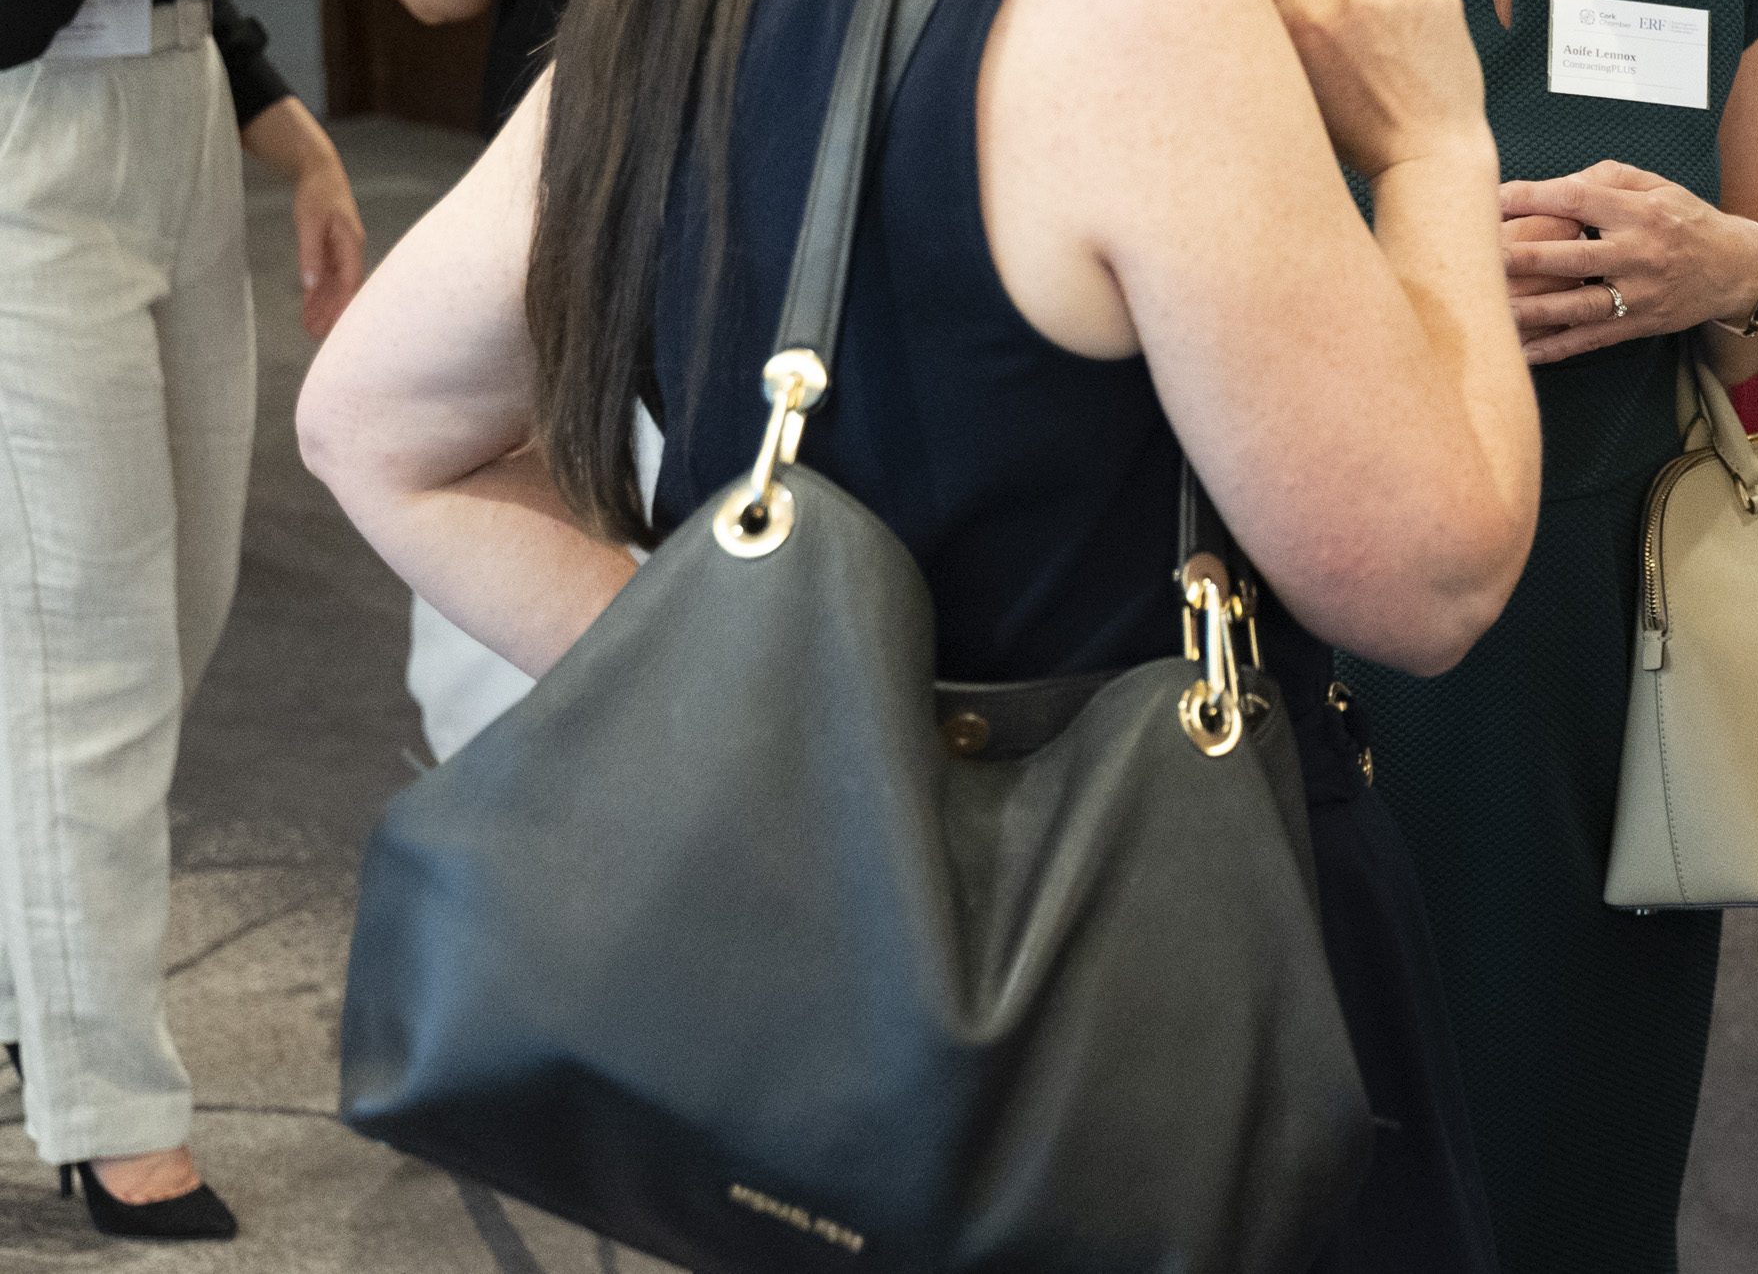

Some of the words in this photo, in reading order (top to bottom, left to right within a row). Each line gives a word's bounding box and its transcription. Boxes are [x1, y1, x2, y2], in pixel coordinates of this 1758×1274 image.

[1599, 12, 1616, 20] Cork
[1639, 17, 1667, 31] ERF
[1563, 44, 1593, 57] Aoife
[1596, 48, 1637, 62] Lennox
